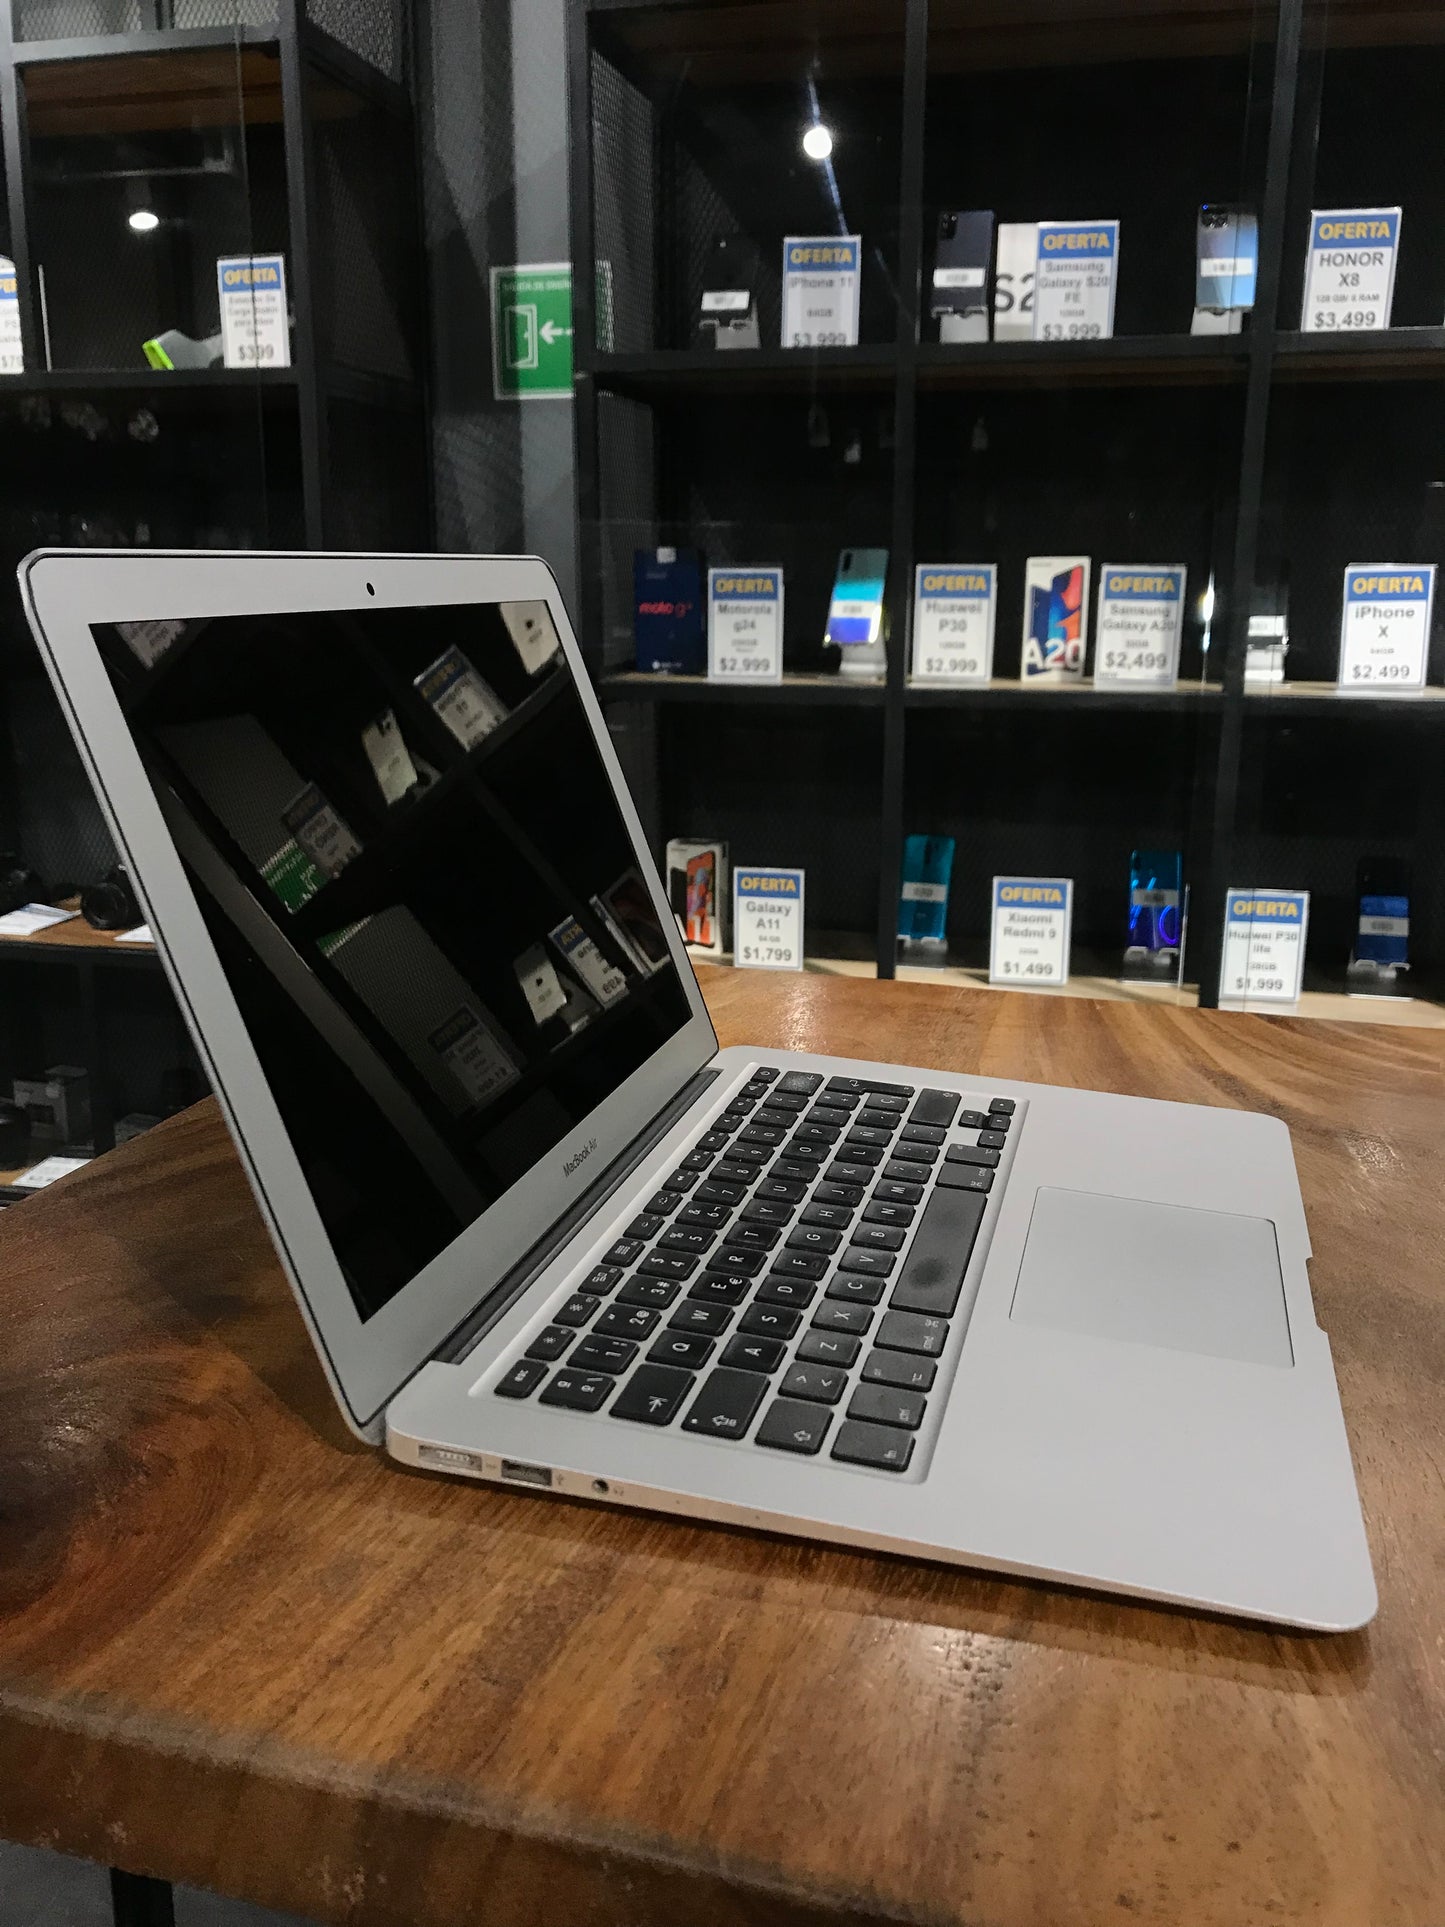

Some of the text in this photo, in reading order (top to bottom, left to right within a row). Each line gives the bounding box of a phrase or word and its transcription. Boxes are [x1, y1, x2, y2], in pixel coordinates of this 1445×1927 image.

[1319, 221, 1390, 240] OFERTA
[1044, 232, 1110, 250] OFERTA
[790, 248, 852, 264] OFERTA
[1320, 252, 1384, 267] HONOR
[224, 268, 278, 286] OFERTA
[1338, 272, 1360, 288] X8
[1314, 310, 1376, 328] $3,499
[1042, 322, 1100, 339] $3999
[793, 332, 848, 346] $3999
[716, 578, 774, 594] OFERTA
[923, 575, 986, 592] OFERTA
[1109, 576, 1176, 592] OFERTA
[1352, 576, 1424, 594] OFERTA
[1110, 604, 1171, 618] Samsung
[1354, 606, 1416, 619] iPhone
[1102, 620, 1146, 632] Galaxy
[1378, 625, 1389, 638] X
[1025, 637, 1085, 670] A20
[1104, 652, 1168, 670] $2,499
[1352, 664, 1410, 680] $2,499
[740, 876, 796, 892] OFERTA
[1000, 886, 1064, 904] OFERTA
[746, 900, 792, 917] Galaxy
[1233, 900, 1298, 918] OFERTA
[756, 918, 780, 930] A11
[1008, 912, 1053, 924] Xiaomi
[1003, 926, 1044, 938] Redmi
[742, 946, 792, 962] $1,799
[1002, 961, 1053, 977] $1,499
[563, 1145, 590, 1178] MacBook
